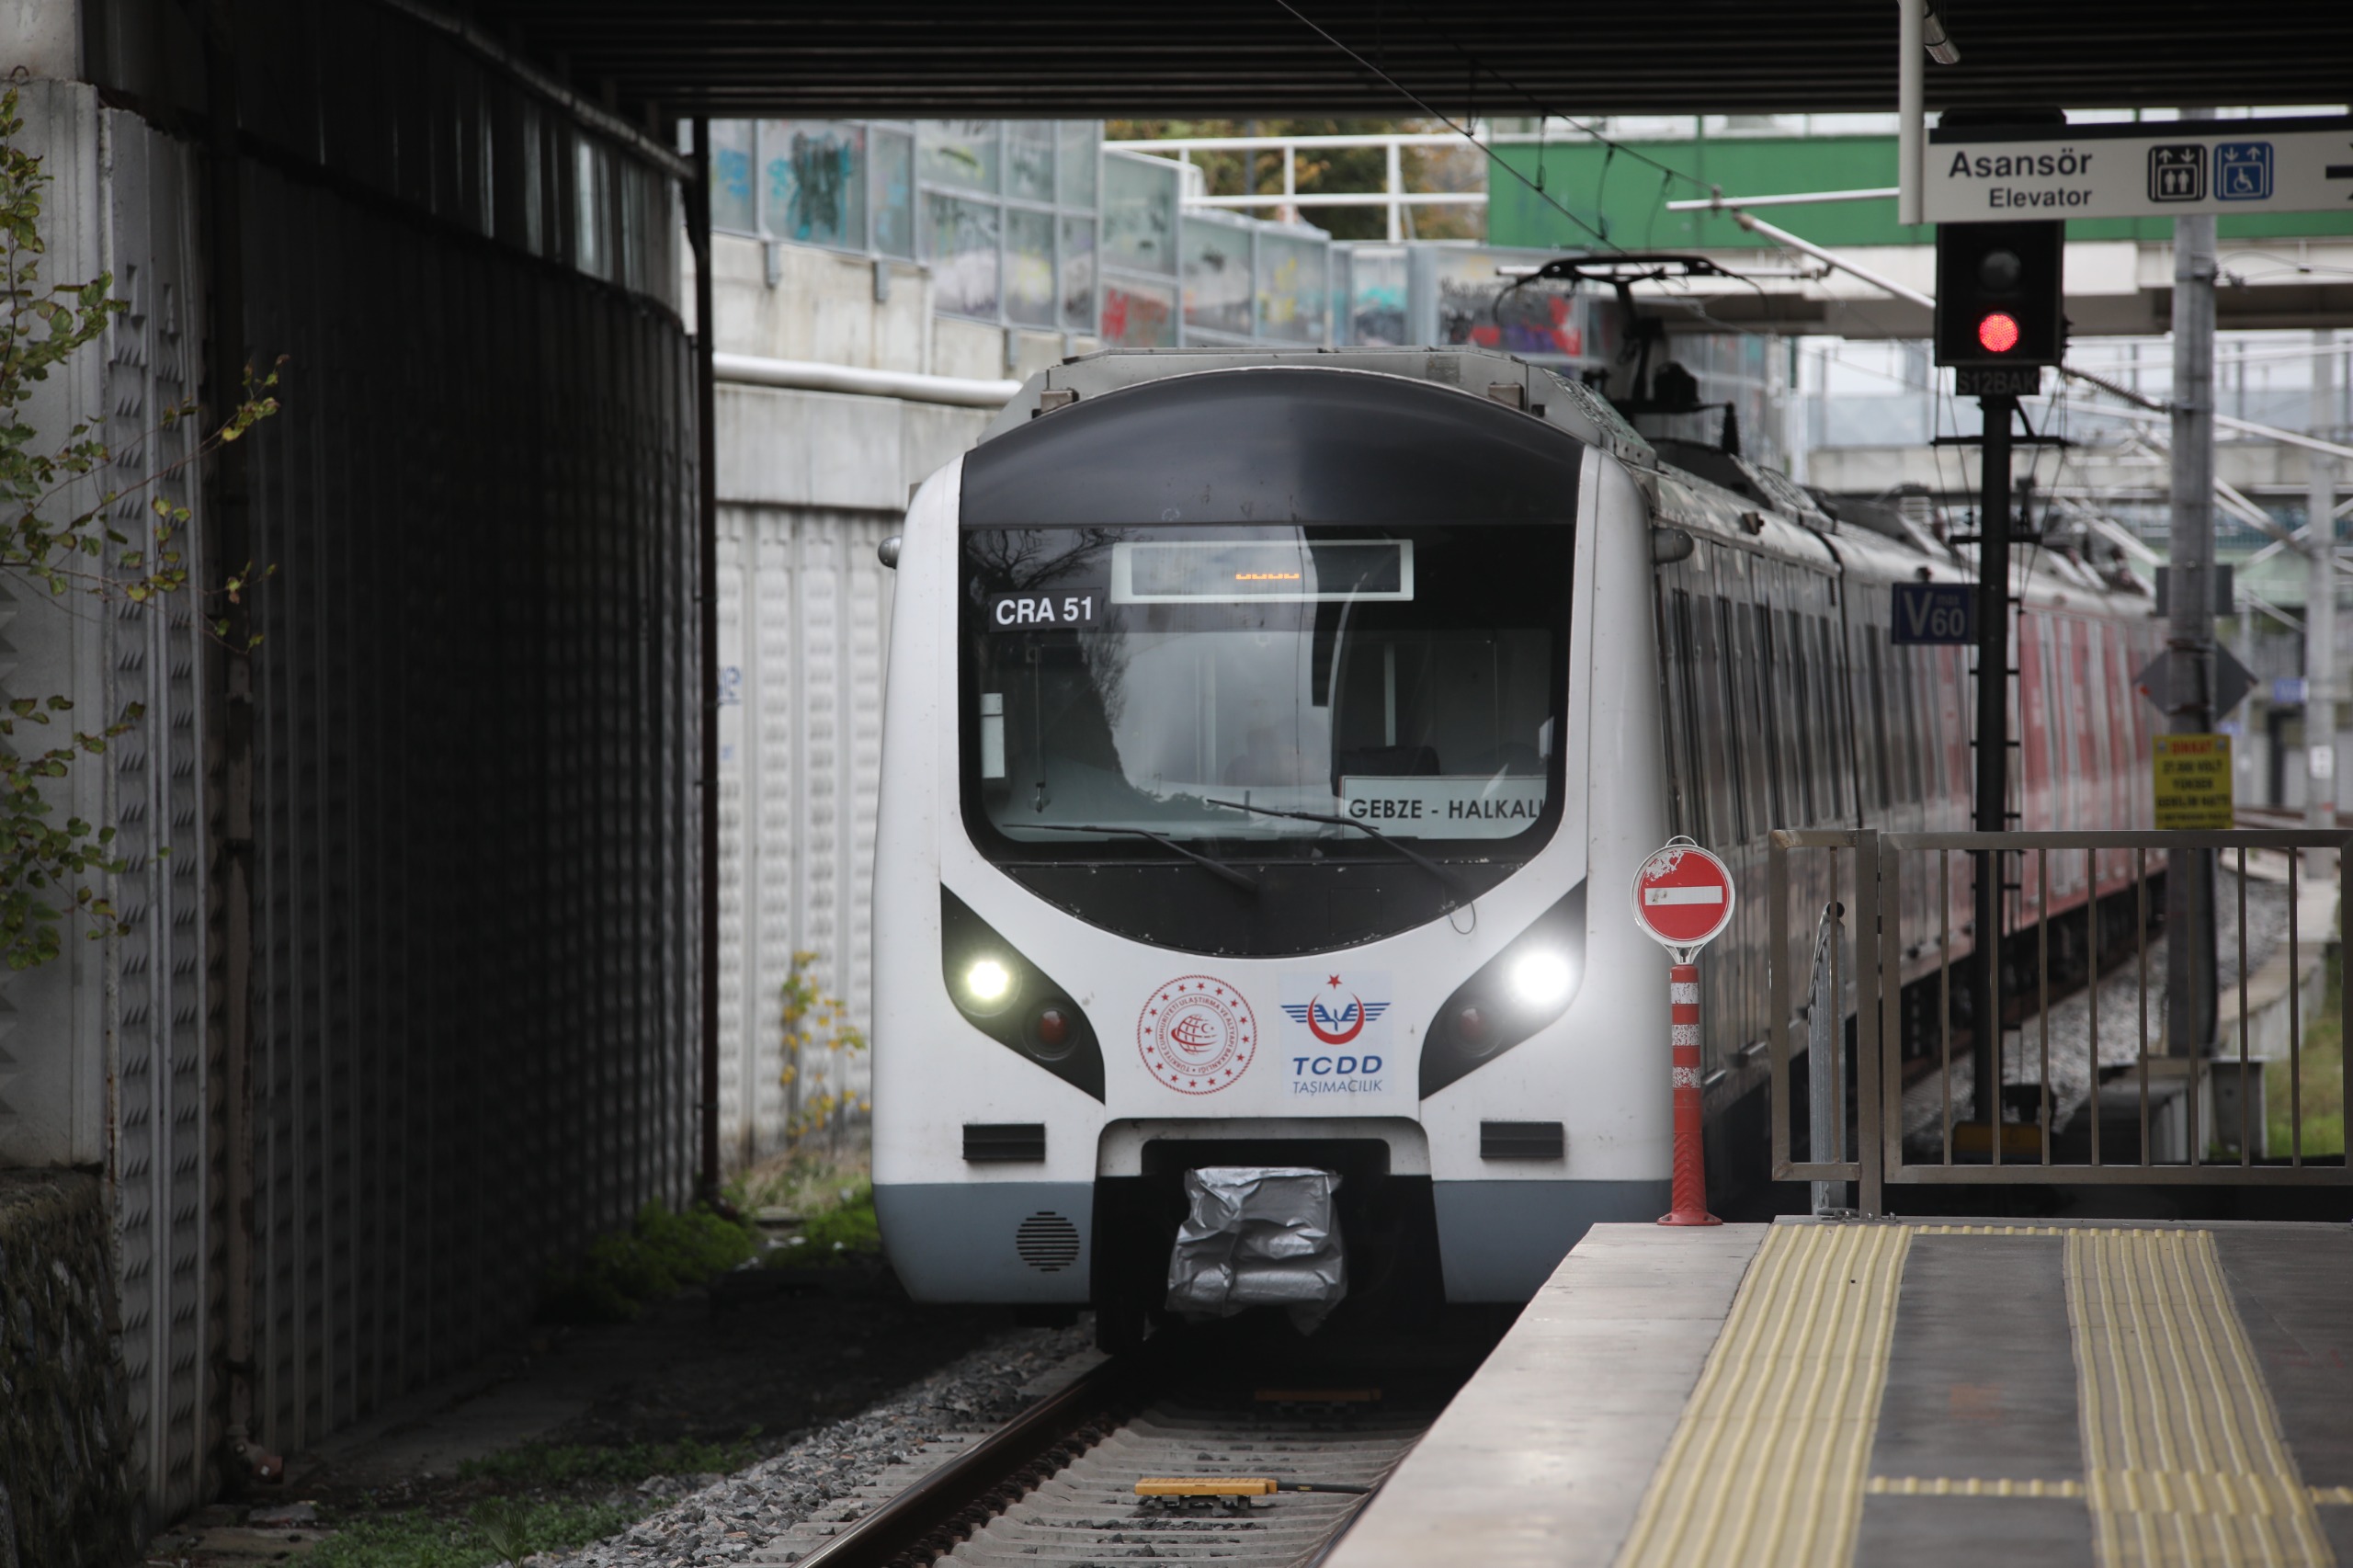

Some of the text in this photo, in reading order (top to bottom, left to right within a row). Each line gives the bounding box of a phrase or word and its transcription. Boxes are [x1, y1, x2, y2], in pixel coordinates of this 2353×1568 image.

[1948, 148, 2093, 177] Asansör
[1988, 187, 2093, 208] Elevator
[1957, 370, 2039, 394] S12BAK
[995, 597, 1092, 625] CRA 51
[1903, 590, 1966, 637] V 60
[1348, 799, 1423, 819] GEBZE
[1178, 996, 1221, 1009] ULAŞTIRMA
[1158, 1002, 1179, 1051] CUMHURİYETİ
[1226, 1017, 1235, 1048] ALTYAPI
[1164, 1051, 1190, 1073] TÜRKİYE
[1292, 1055, 1383, 1075] TCDD
[1292, 1079, 1383, 1096] TAŞIMACILIK
